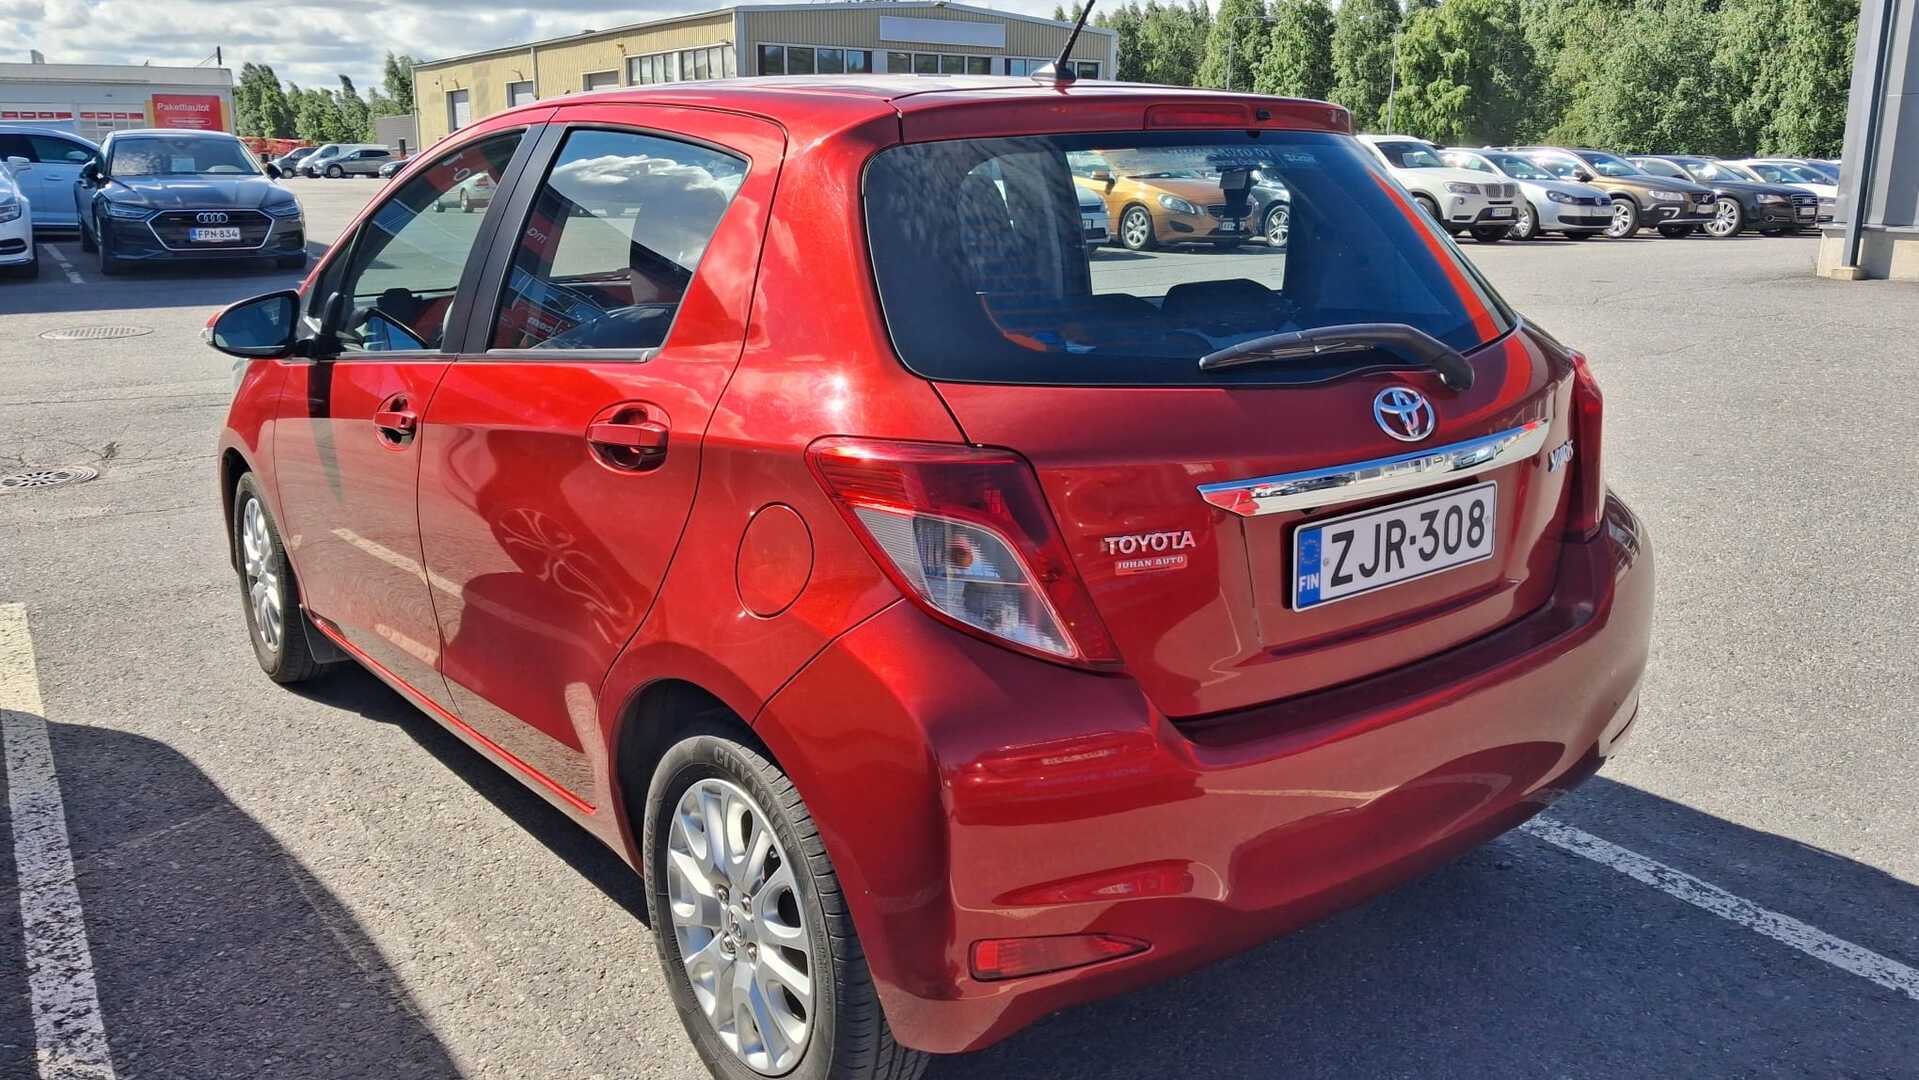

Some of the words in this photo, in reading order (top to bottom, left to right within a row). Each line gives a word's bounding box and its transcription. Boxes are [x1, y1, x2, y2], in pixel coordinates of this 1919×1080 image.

[157, 102, 210, 112] Pakettiautot
[198, 229, 238, 239] FPN-834
[1103, 530, 1197, 555] TOYOTA
[1331, 498, 1486, 588] ZJR-308
[1154, 555, 1185, 566] AUTO
[1298, 573, 1320, 593] FIN
